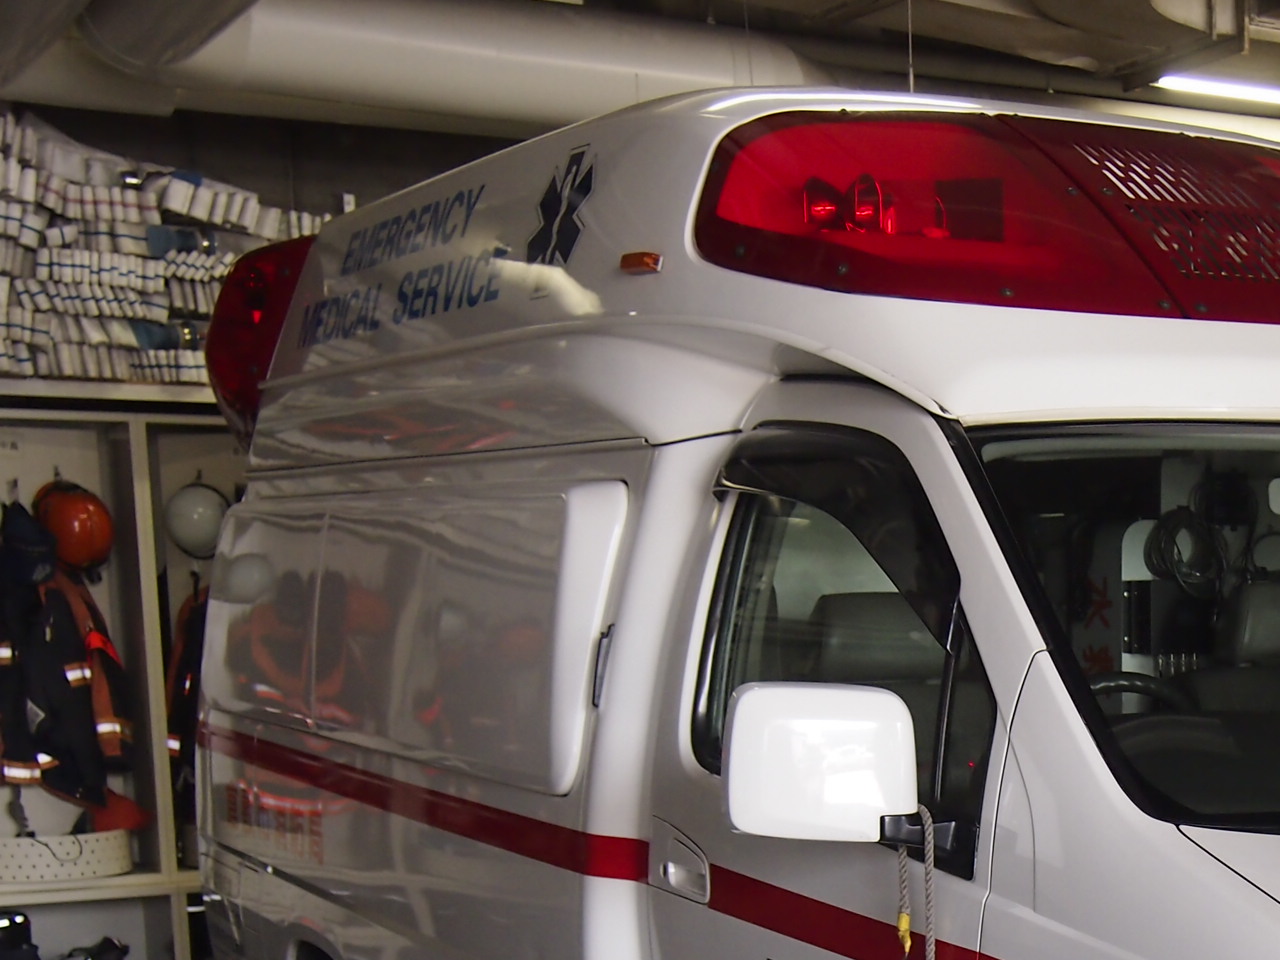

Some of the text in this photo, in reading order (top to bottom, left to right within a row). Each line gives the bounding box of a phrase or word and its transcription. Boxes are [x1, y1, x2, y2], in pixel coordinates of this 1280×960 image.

[340, 184, 486, 277] EMERGENCY
[298, 245, 509, 347] MEDICAL SERVICE
